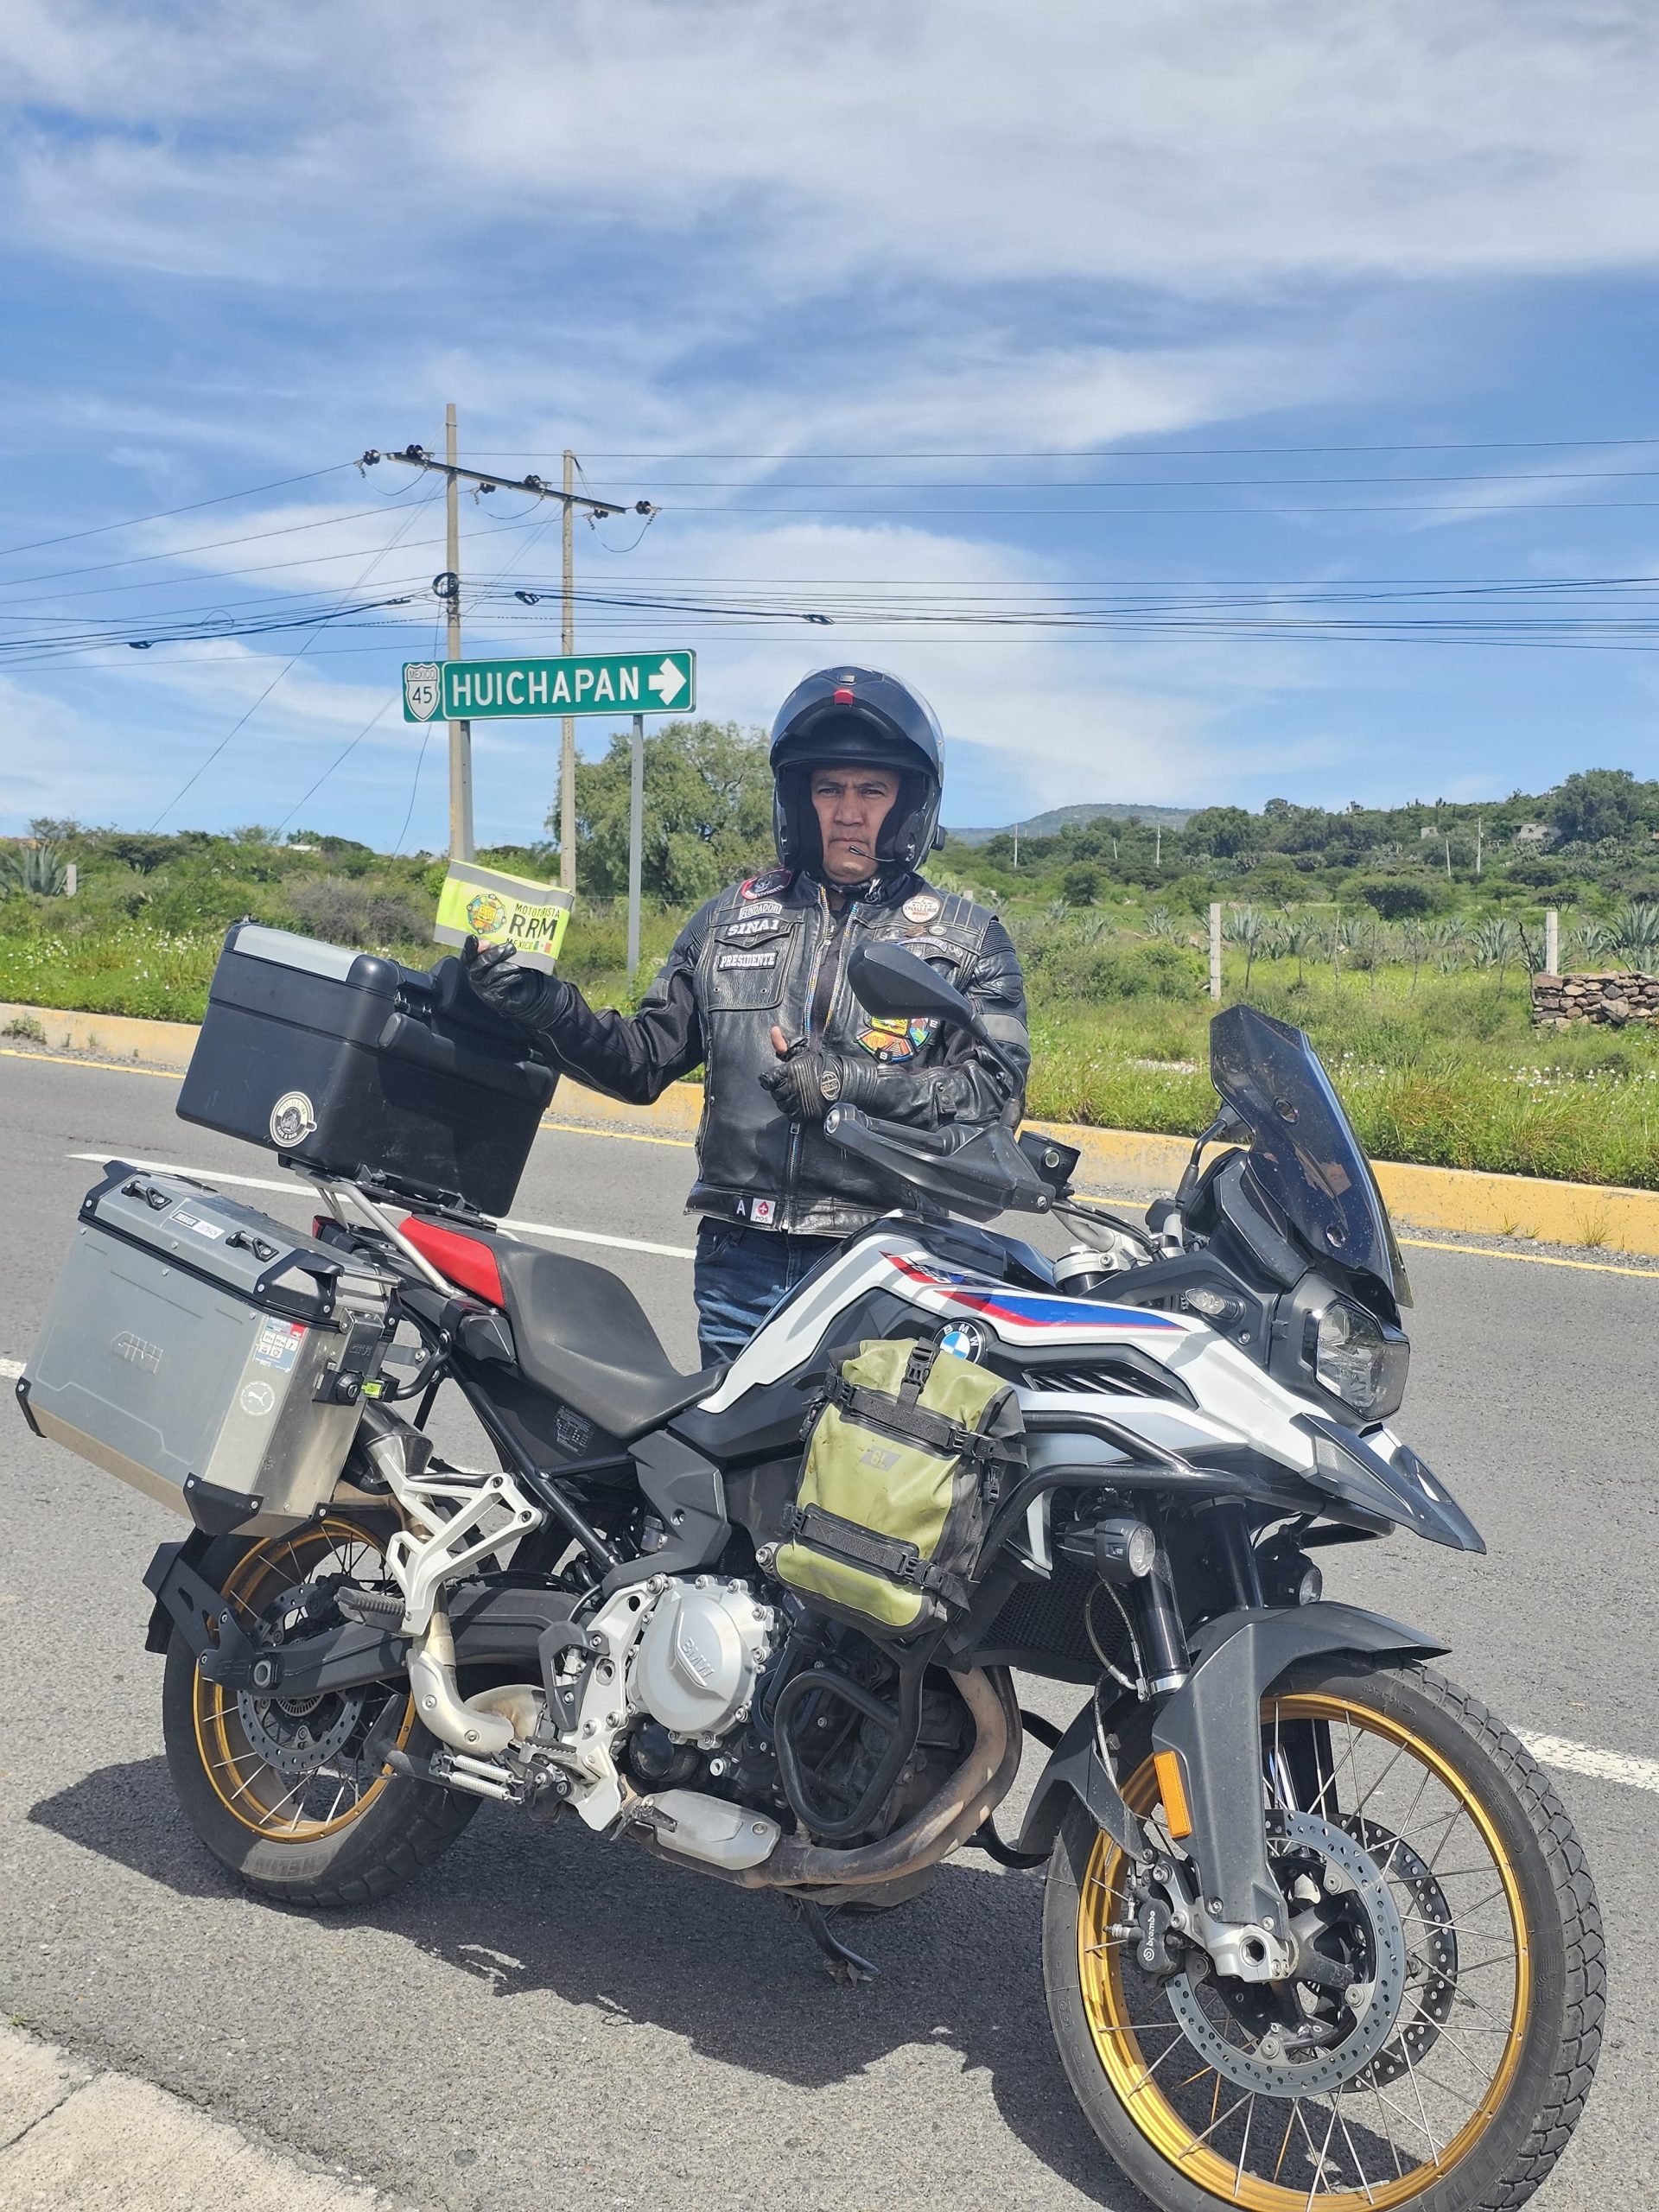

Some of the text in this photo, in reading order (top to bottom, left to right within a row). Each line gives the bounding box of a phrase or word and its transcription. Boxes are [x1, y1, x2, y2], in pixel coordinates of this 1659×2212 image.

[412, 686, 433, 704] 45
[452, 666, 639, 707] HUICHAPAN
[741, 903, 781, 918] FUNDADOR
[508, 912, 558, 942] RRM
[728, 919, 780, 937] SINAI
[719, 952, 777, 969] PRESIDENTE
[736, 1199, 746, 1217] A
[943, 1323, 981, 1348] BMW
[870, 1450, 887, 1469] 6L
[681, 1636, 715, 1680] BMW
[1147, 1910, 1156, 1948] brembo
